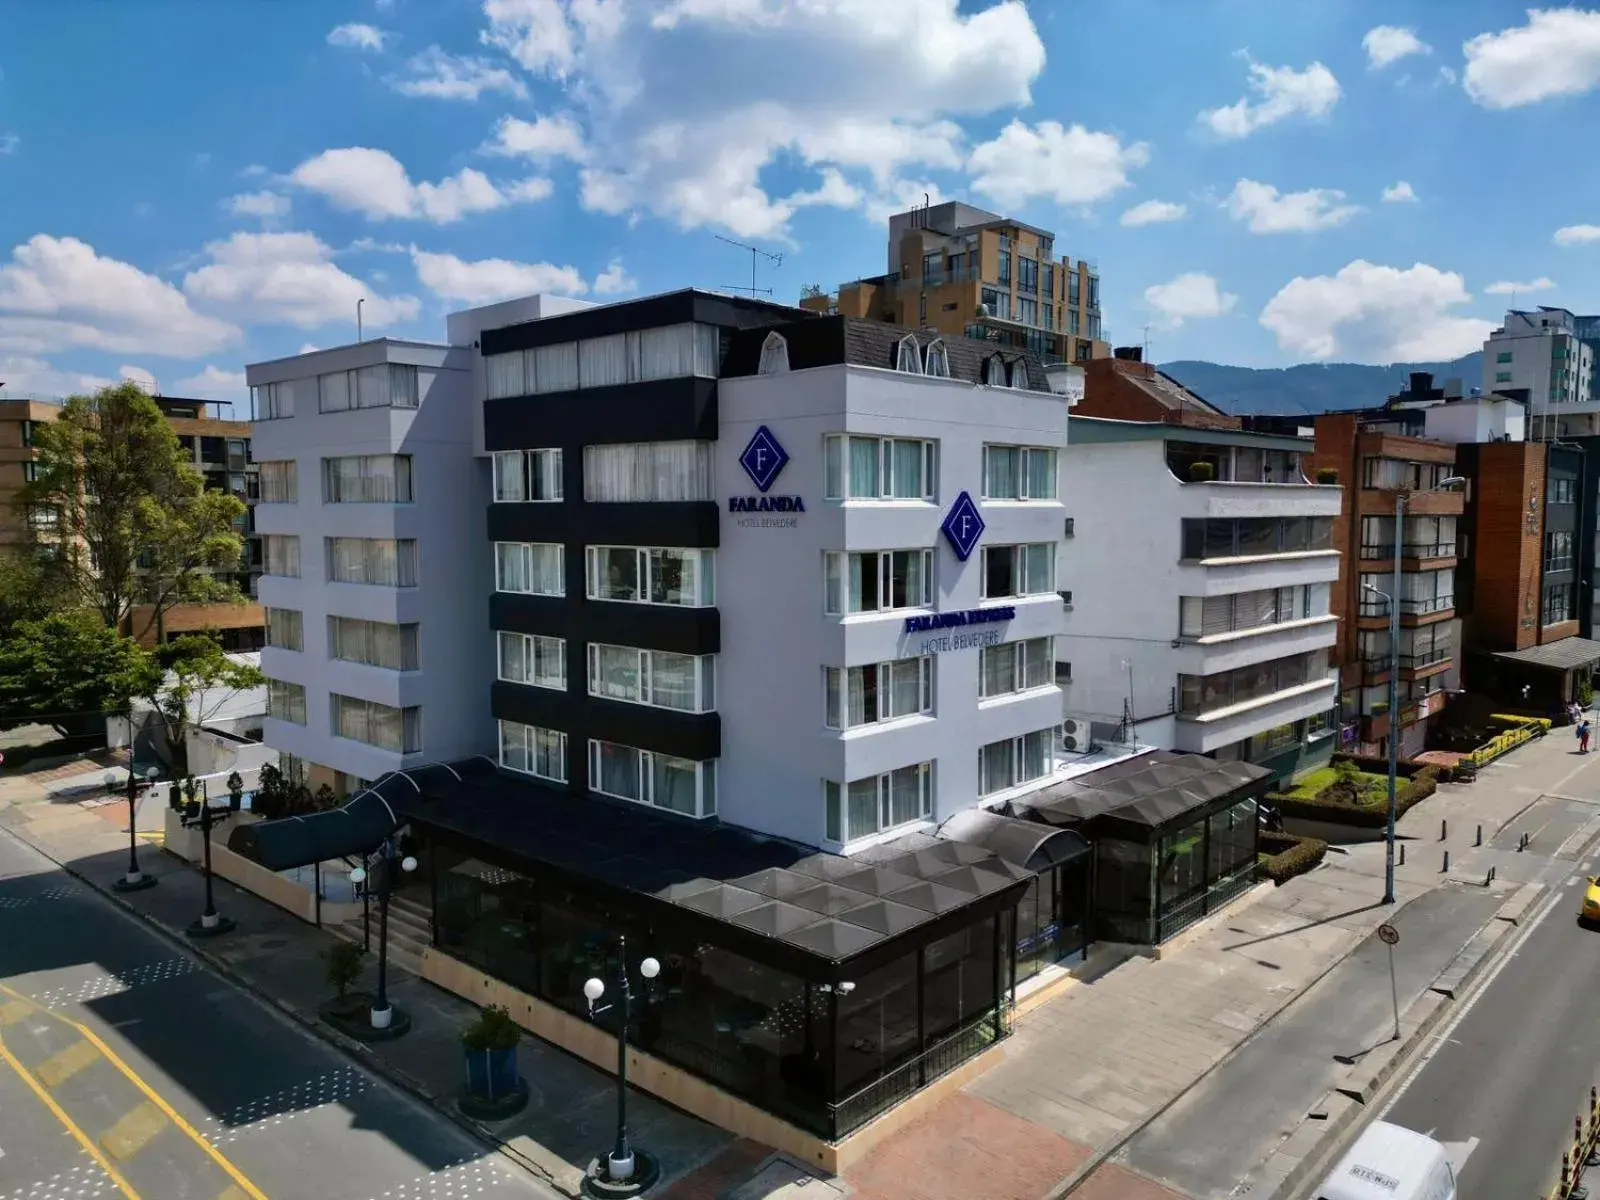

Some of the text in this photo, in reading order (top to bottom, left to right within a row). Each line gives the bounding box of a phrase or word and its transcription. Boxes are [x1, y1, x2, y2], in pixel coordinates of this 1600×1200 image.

[756, 448, 767, 470] F
[729, 496, 805, 512] FARANDA
[737, 518, 798, 528] HOTEL BELVEDERE
[962, 515, 971, 538] F
[905, 613, 968, 633] FARANDA
[920, 630, 999, 655] HOTEL BELVEDERE
